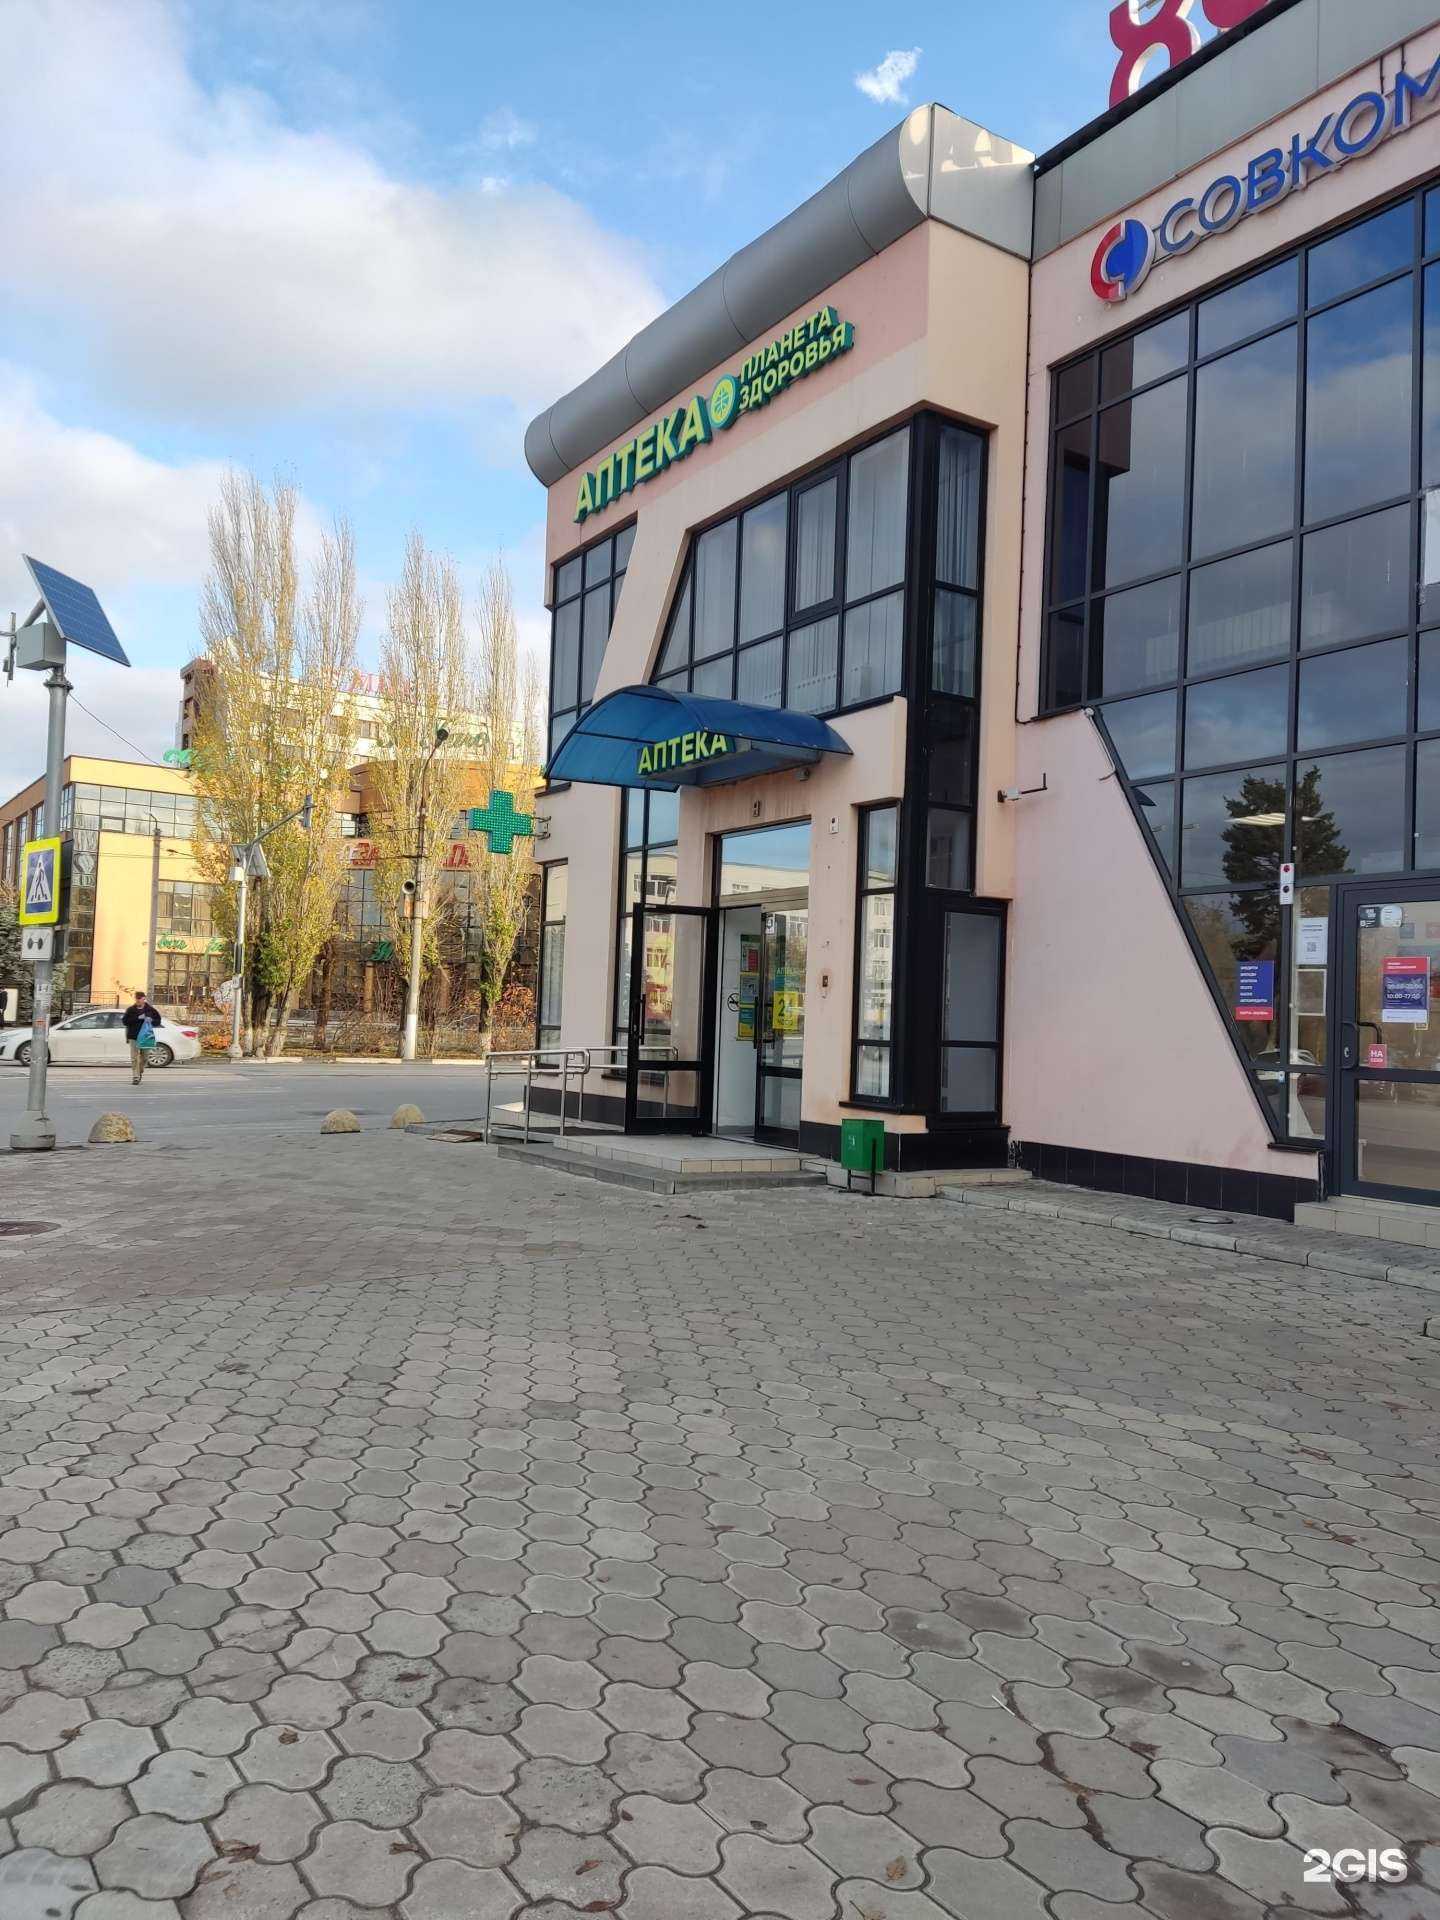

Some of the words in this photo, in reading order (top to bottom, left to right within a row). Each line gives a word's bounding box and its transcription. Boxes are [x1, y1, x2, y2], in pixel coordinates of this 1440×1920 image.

[738, 322, 852, 411] ЗДОРОВЬЯ
[740, 306, 836, 384] ПЛАНЕТА
[574, 395, 711, 523] АПТЕКА
[638, 730, 728, 774] АПТЕКА
